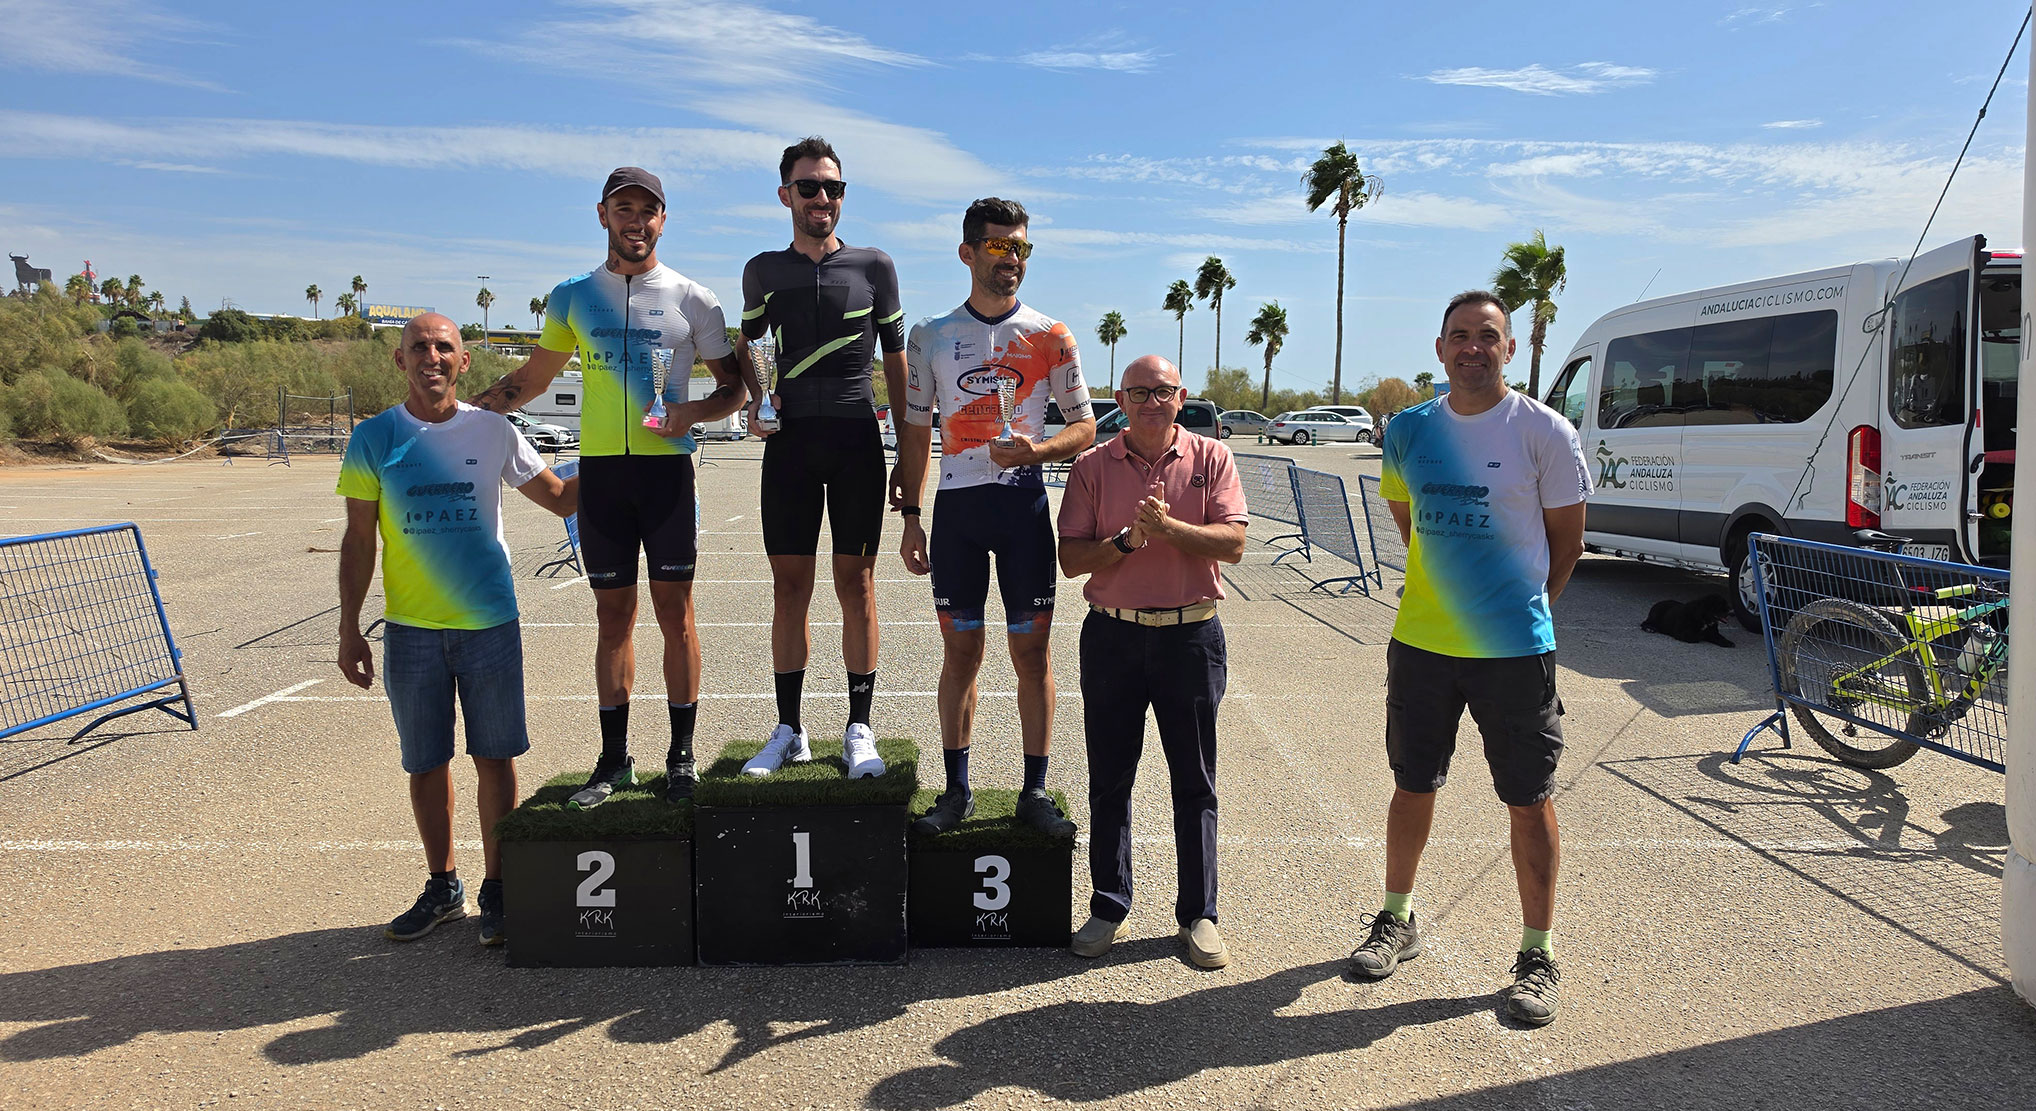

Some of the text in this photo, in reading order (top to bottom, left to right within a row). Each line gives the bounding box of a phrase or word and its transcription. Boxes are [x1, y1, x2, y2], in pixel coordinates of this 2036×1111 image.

[1700, 285, 1844, 317] ANDALUCIACICLISMO.COM
[1631, 453, 1675, 466] FEDERACIÓN
[1630, 468, 1673, 479] ANDALUZA
[1629, 480, 1674, 492] CICLISMO
[1910, 480, 1951, 491] FEDERACIÓN
[1906, 501, 1947, 511] CICLISMO
[1908, 492, 1947, 500] ANDALUZA
[793, 832, 813, 888] 1
[576, 850, 616, 907] 2
[973, 855, 1011, 910] 3
[787, 890, 821, 910] KRK
[580, 909, 613, 930] KRK
[976, 912, 1008, 932] KRK
